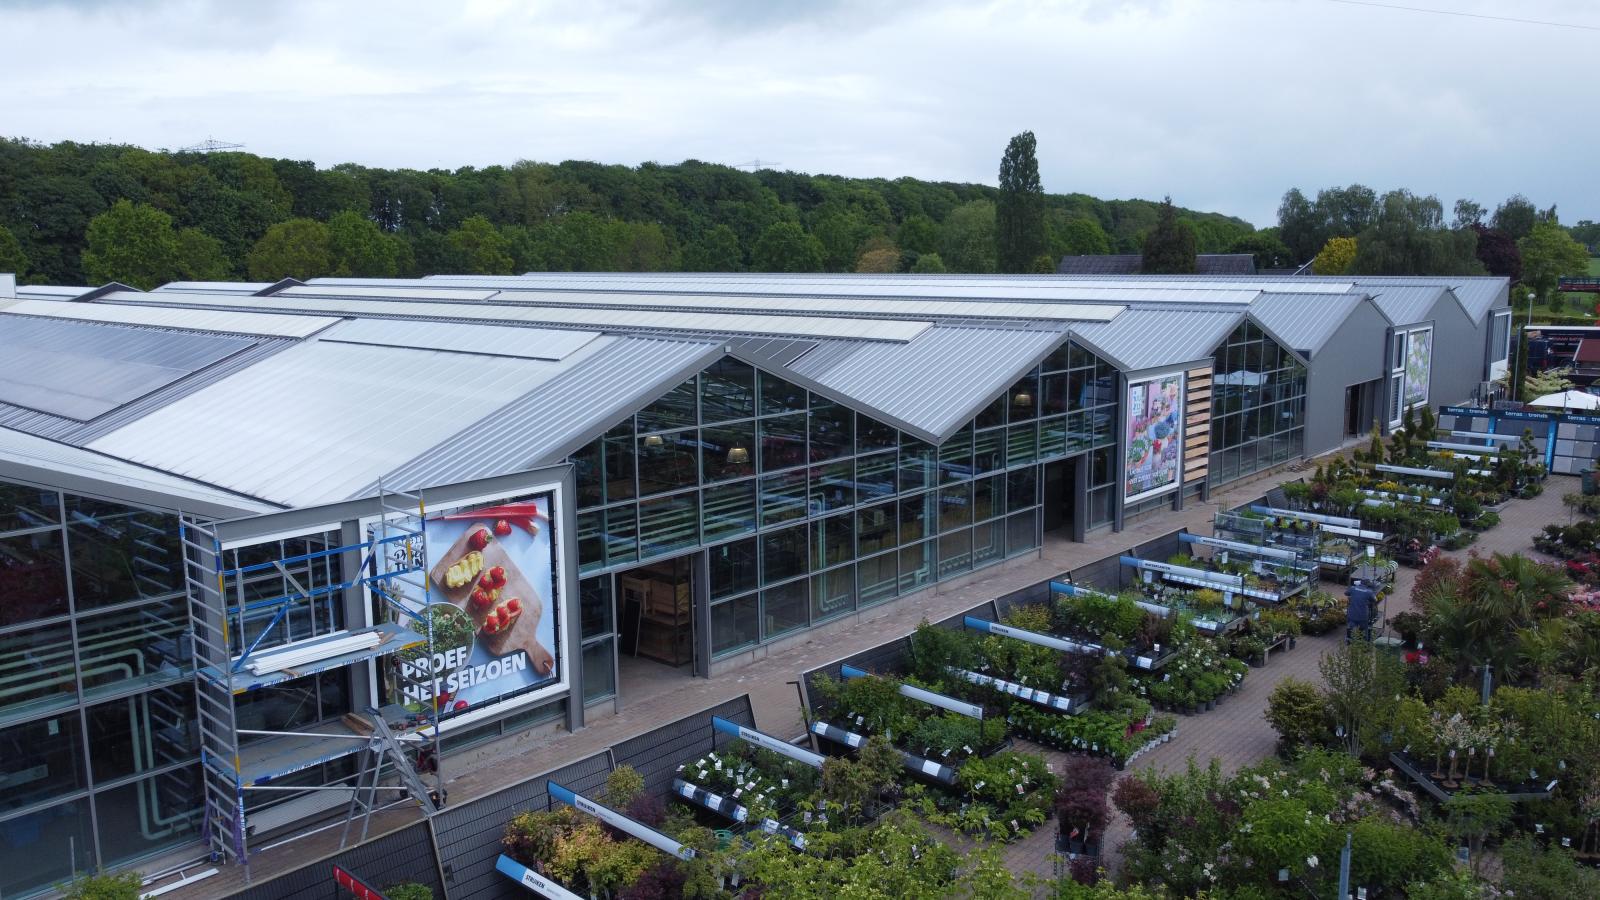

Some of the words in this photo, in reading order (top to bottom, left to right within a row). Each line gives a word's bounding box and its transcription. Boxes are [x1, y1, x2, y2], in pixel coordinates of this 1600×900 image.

[401, 645, 467, 681] PROEF
[403, 677, 443, 706] HET
[446, 651, 527, 694] SEIZOEN
[525, 874, 546, 889] STRUIKEN
